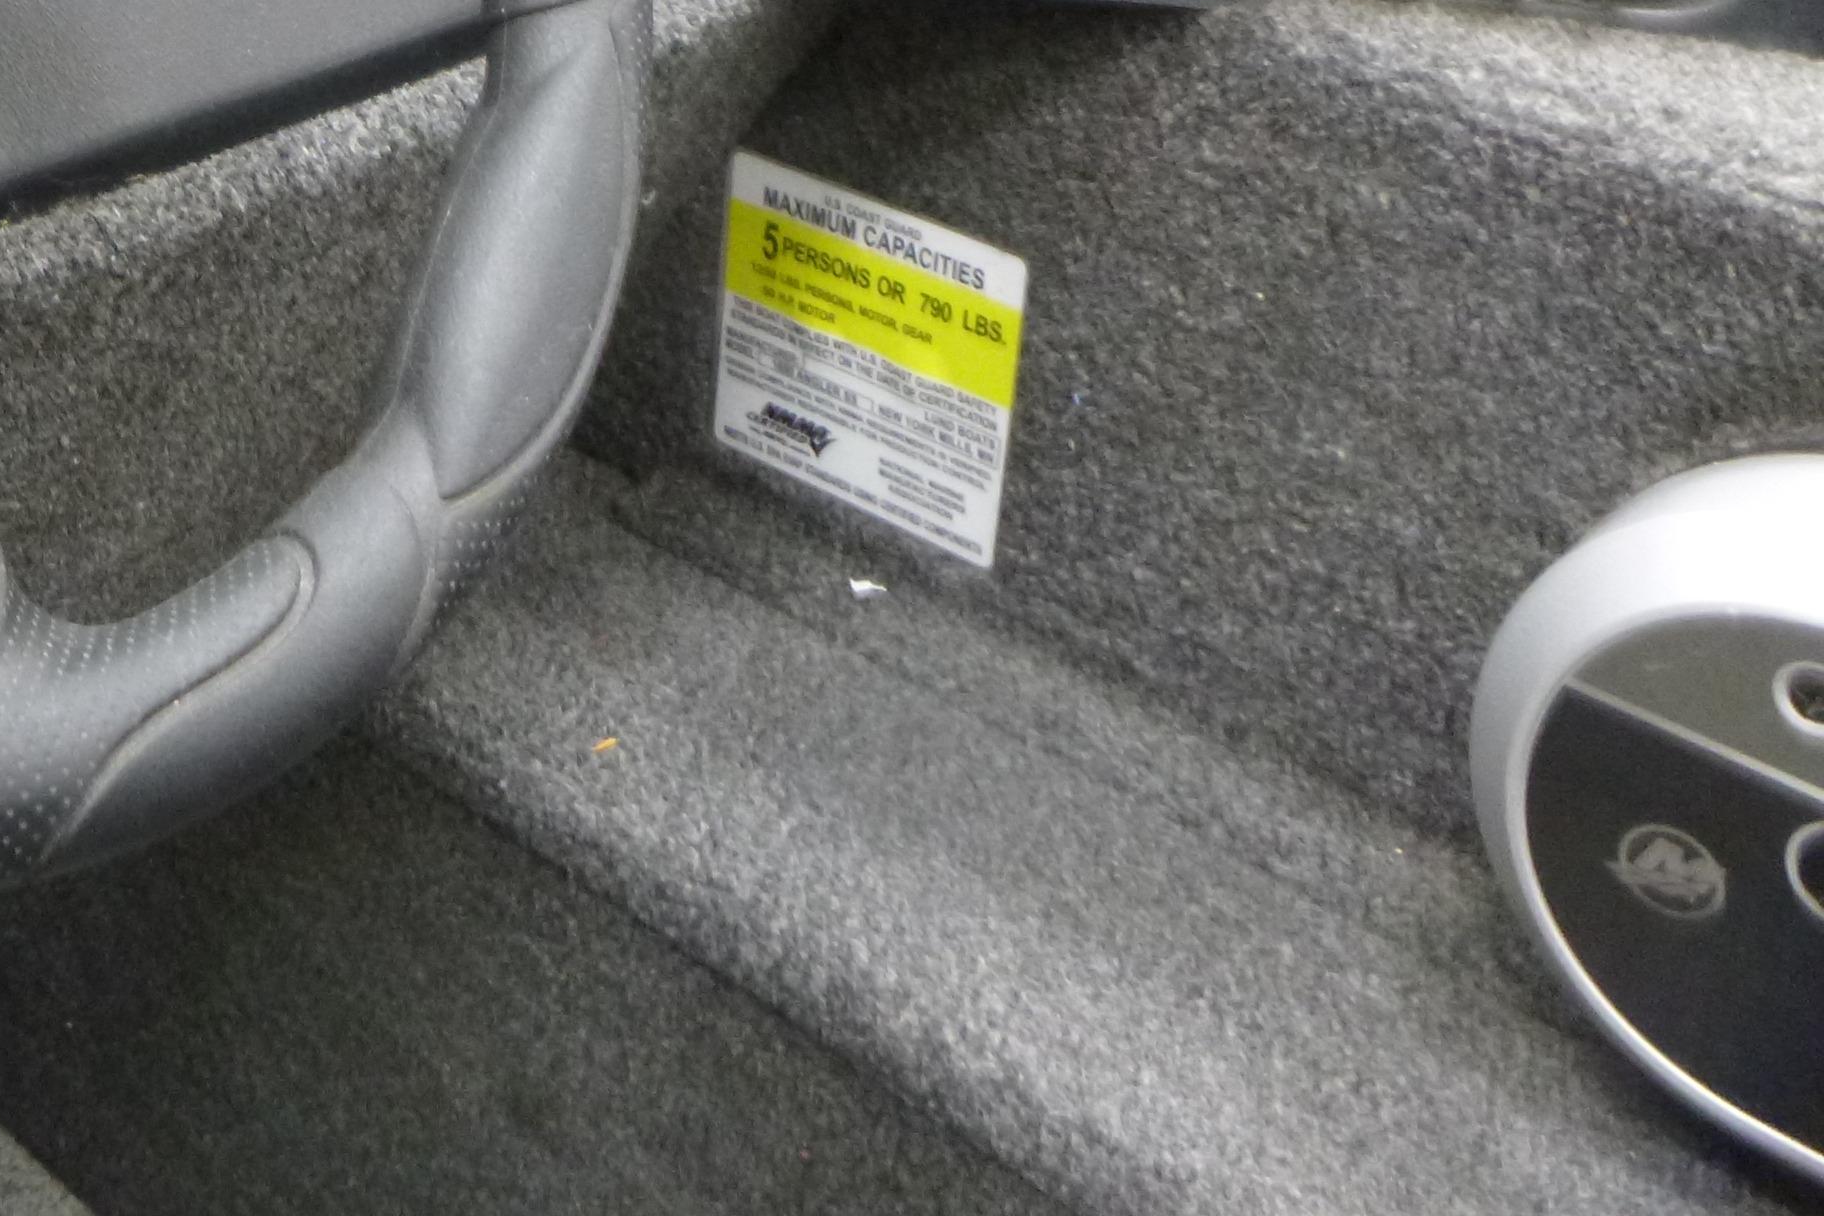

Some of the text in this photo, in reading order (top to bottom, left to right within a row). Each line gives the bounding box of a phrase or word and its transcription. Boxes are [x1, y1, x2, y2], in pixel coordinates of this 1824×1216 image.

[761, 219, 780, 261] 5
[781, 235, 871, 289] PERSONS
[877, 275, 906, 305] OR
[919, 292, 953, 323] 790
[762, 185, 985, 290] MAXIMUM CAPACITIES
